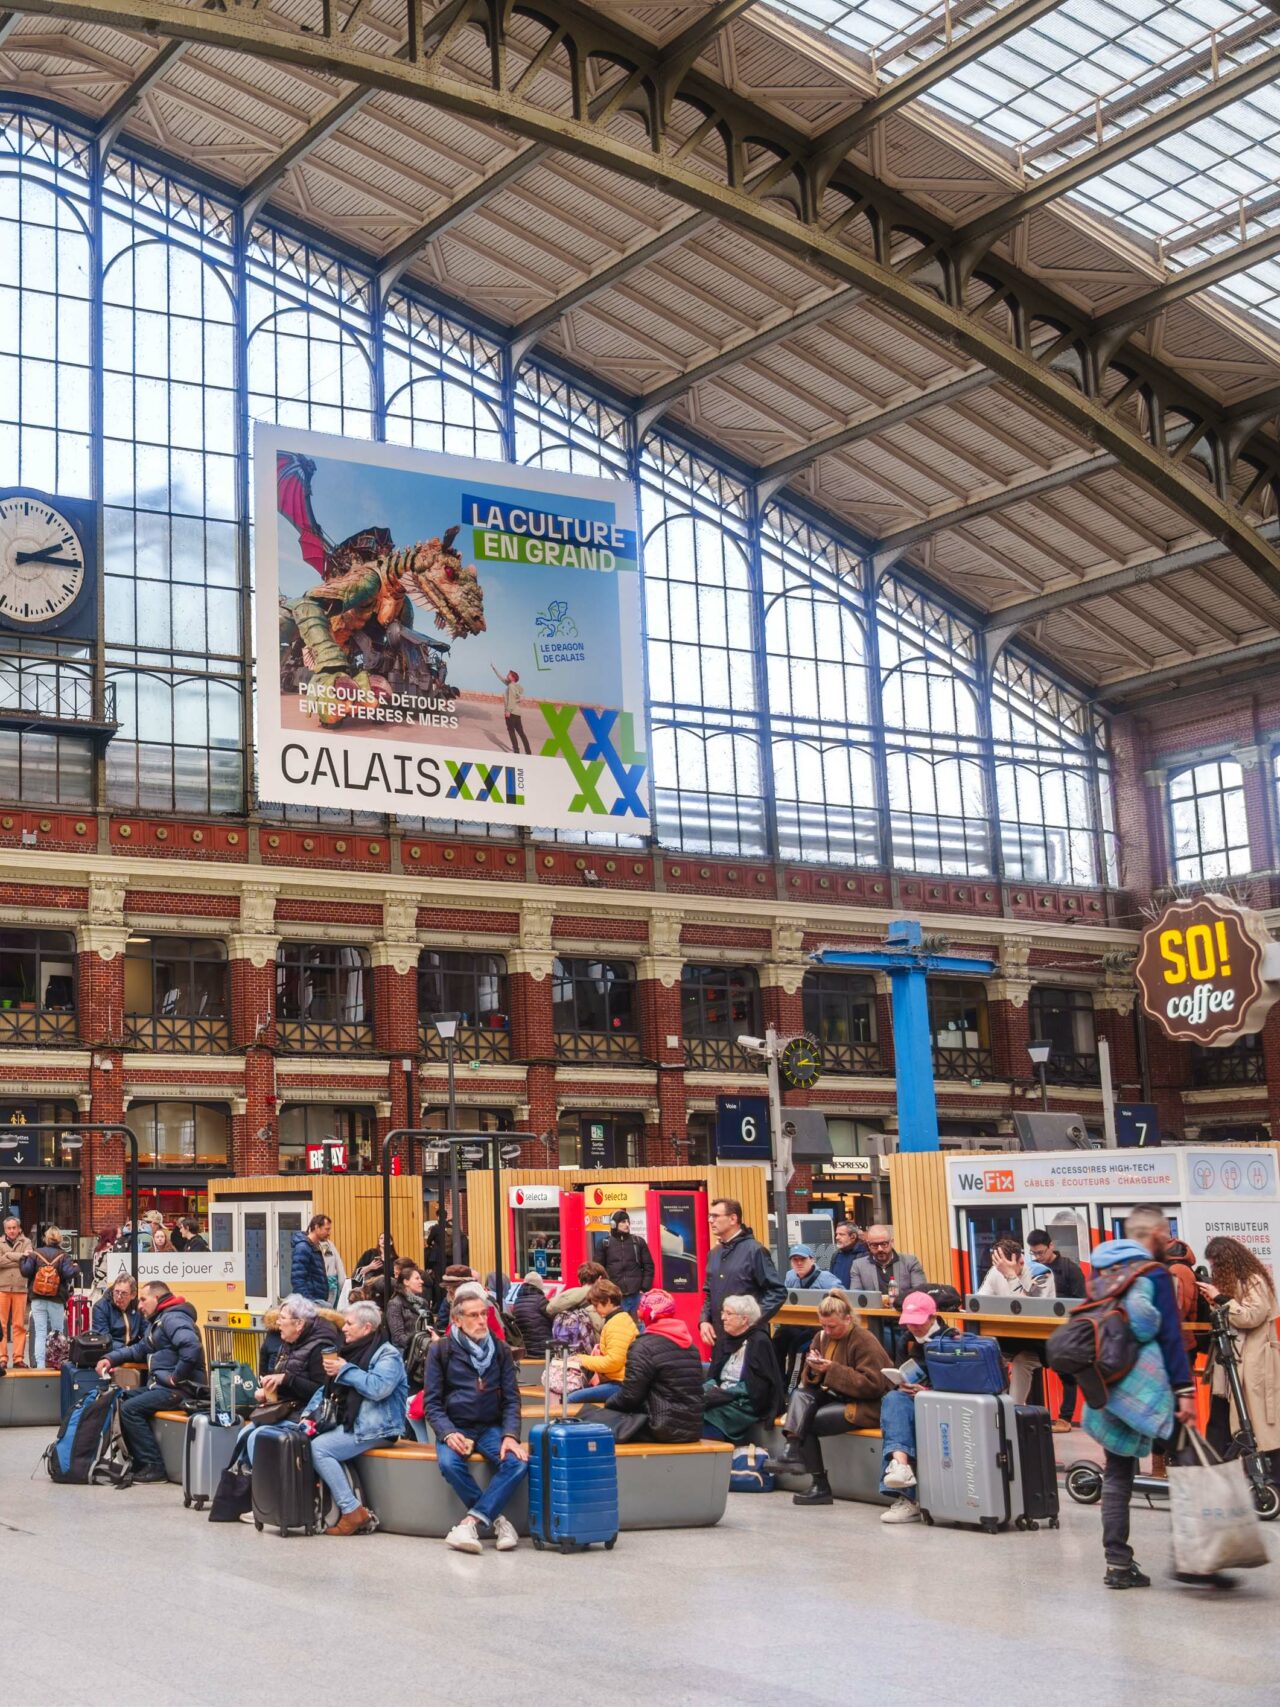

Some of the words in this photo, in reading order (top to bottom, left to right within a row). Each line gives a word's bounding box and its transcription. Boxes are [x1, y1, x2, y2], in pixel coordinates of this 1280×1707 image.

[472, 503, 503, 531] LA
[508, 508, 626, 549] CULTURE
[483, 530, 519, 560] EN
[525, 539, 617, 573] GRAND
[540, 644, 550, 653] LE
[551, 642, 585, 652] DRAGON
[543, 654, 554, 663] DE
[554, 652, 586, 662] CALAIS
[297, 681, 375, 705] PARCOURS
[378, 691, 387, 704] &
[391, 690, 456, 713] DÉTOURS
[298, 699, 347, 719] ENTRE
[348, 704, 404, 724] TERRES
[405, 711, 415, 725] &
[418, 713, 459, 730] MERS
[1159, 920, 1232, 985] SO!
[1166, 983, 1235, 1025] coffee
[741, 1116, 757, 1142] 6
[1135, 1122, 1147, 1146] 7
[309, 1147, 344, 1170] REAY
[830, 1161, 869, 1170] NESPRESSO
[1051, 1165, 1107, 1174] ACCESSOIRES
[1109, 1163, 1155, 1173] HIGH-TECH
[958, 1172, 1014, 1191] WeFix
[1024, 1177, 1055, 1187] CÂBLES
[1061, 1176, 1111, 1187] ÉCOUTEURS
[1118, 1175, 1171, 1185] CHARGEURS
[525, 1193, 548, 1201] selecta
[604, 1192, 628, 1202] selecta
[1205, 1222, 1269, 1232] DISTRIBUTEUR
[118, 1259, 128, 1274] À
[138, 1264, 160, 1275] ous
[162, 1261, 179, 1275] de
[181, 1262, 213, 1278] jouer
